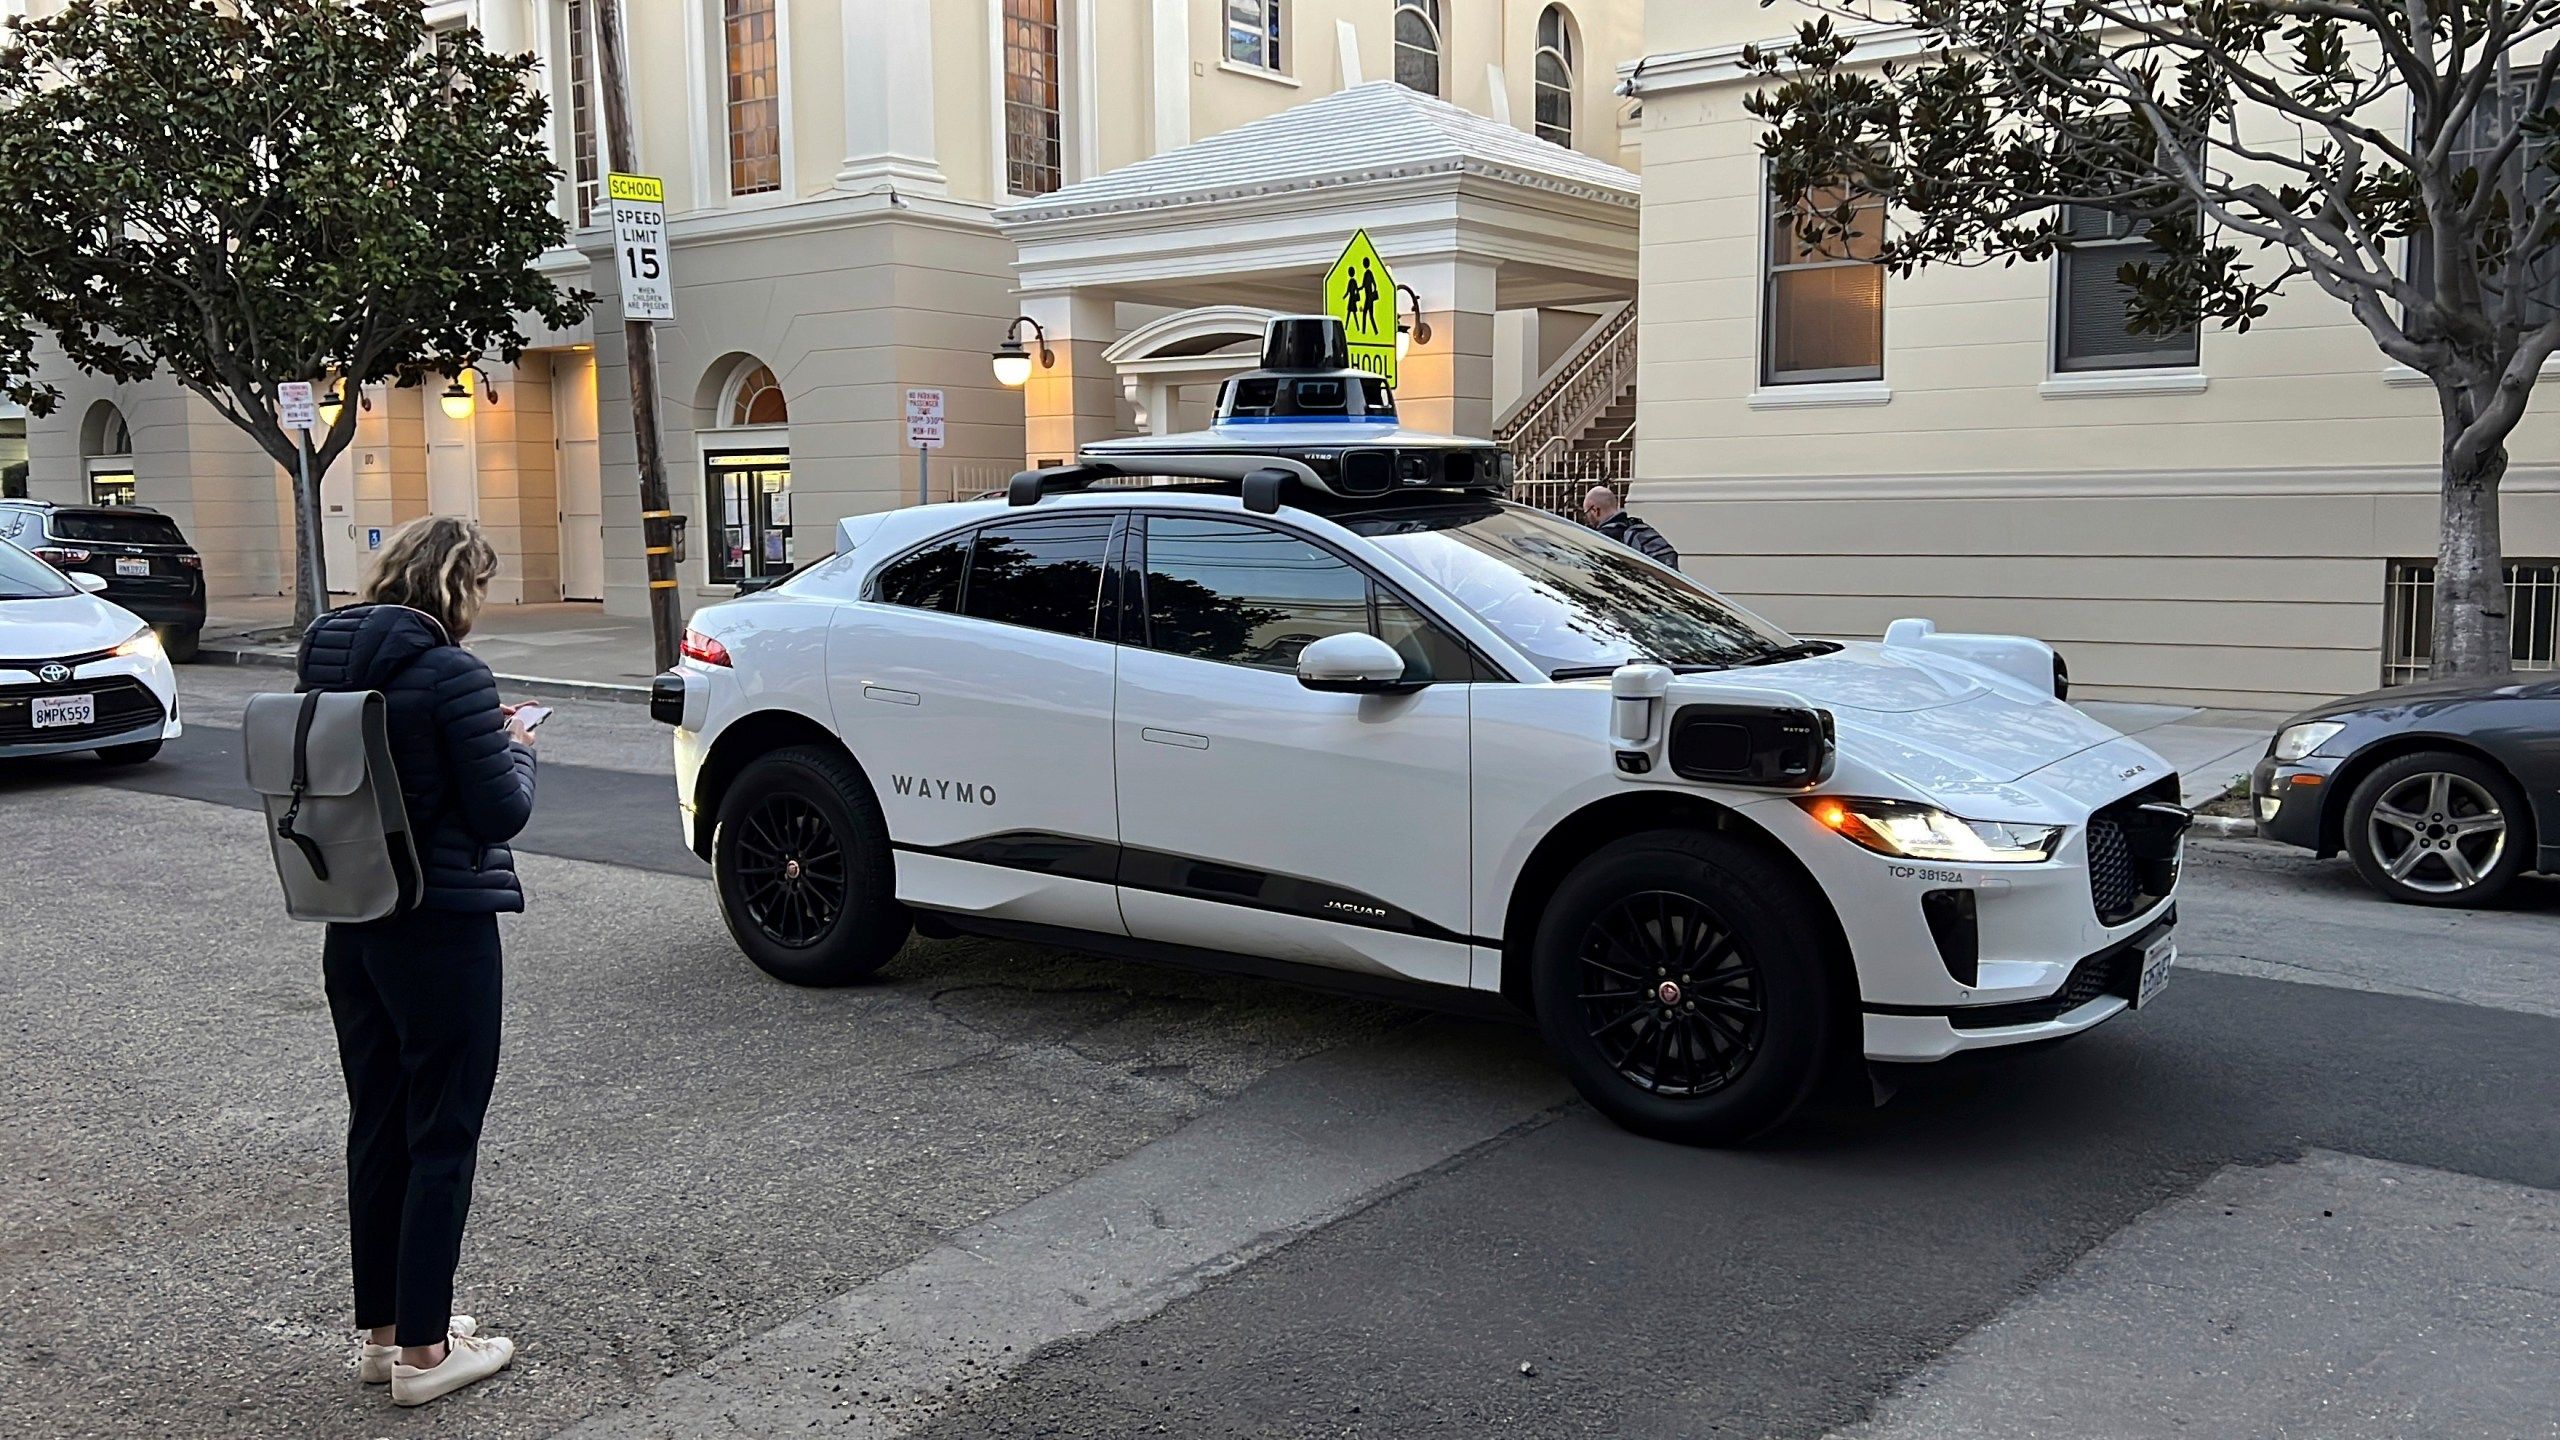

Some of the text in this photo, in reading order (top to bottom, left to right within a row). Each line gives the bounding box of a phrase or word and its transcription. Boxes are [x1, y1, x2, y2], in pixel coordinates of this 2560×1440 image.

[612, 180, 660, 197] SCHOOL
[617, 209, 661, 225] SPEED
[623, 228, 657, 243] LIMIT
[627, 247, 660, 279] 15
[633, 294, 662, 302] CHILDREN
[642, 302, 669, 310] PRESENT
[1351, 353, 1392, 378] HOOL
[917, 392, 940, 400] PARKING
[36, 706, 90, 724] 8MPK559
[891, 774, 996, 806] WAYMO
[1888, 865, 1963, 883] TCP 38152A
[1324, 901, 1386, 918] JAGUAR
